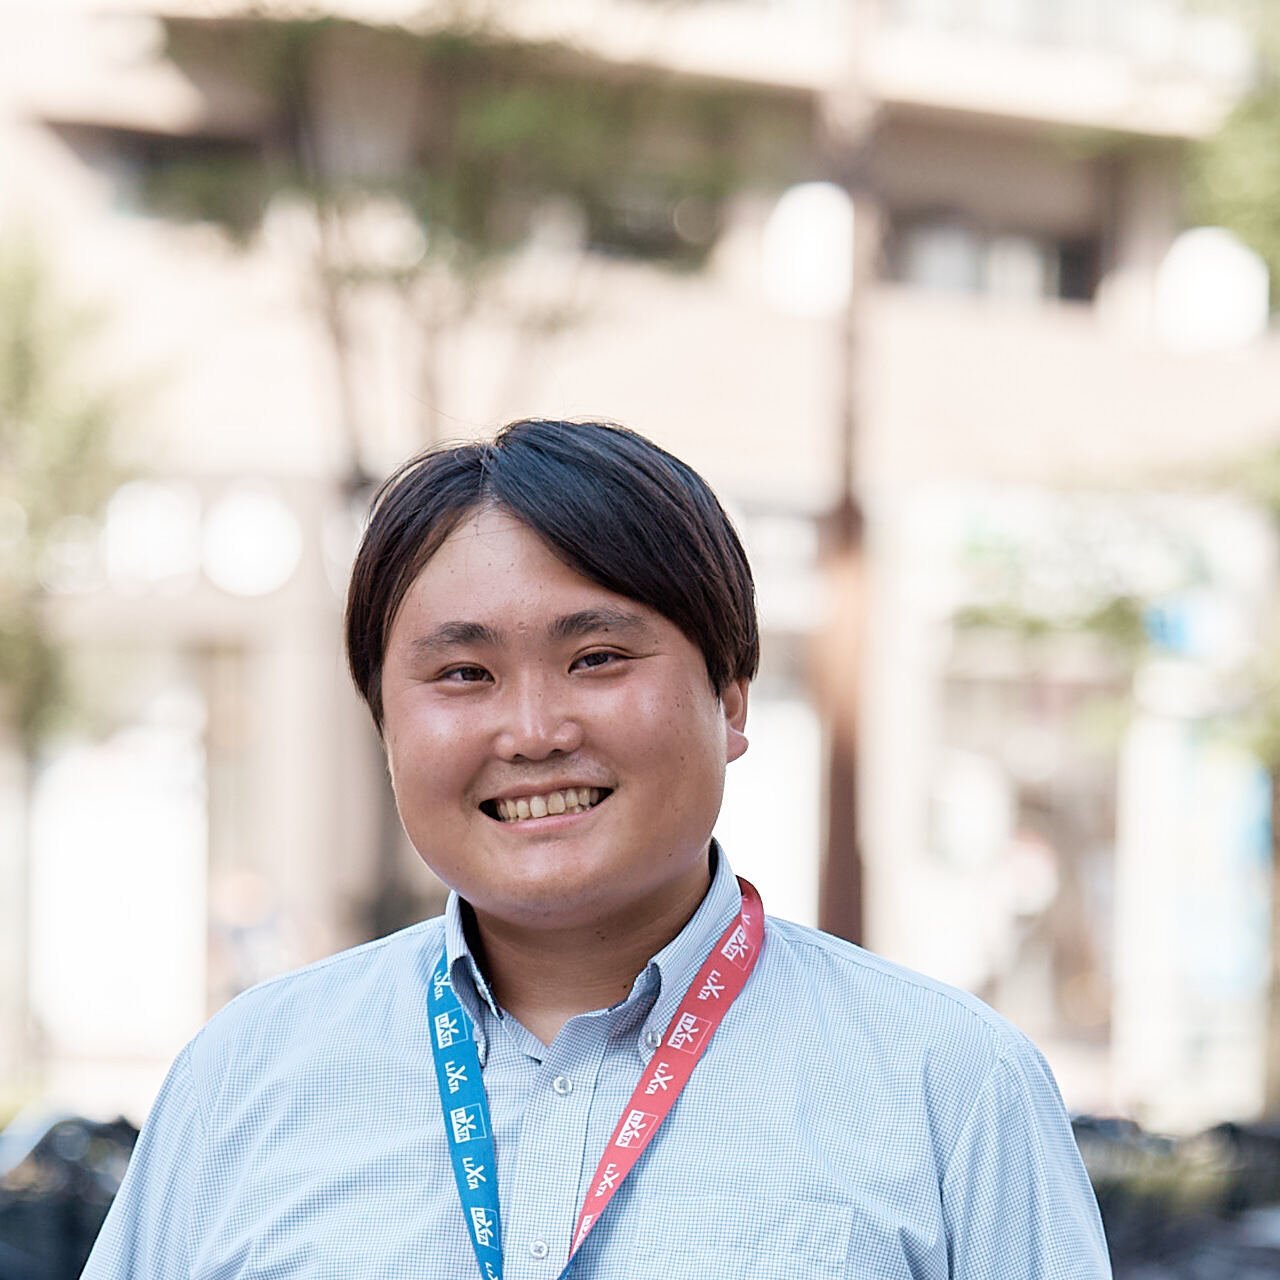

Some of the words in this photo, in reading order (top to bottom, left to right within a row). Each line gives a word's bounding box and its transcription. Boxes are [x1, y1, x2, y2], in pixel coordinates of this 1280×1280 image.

[697, 969, 725, 1000] LIXTA
[439, 1015, 459, 1046] LIXTA
[671, 1015, 699, 1045] LIXTA
[445, 1061, 468, 1094] LIXTA
[644, 1062, 674, 1095] LIXTA
[455, 1110, 477, 1140] LIXTA
[618, 1113, 647, 1145] LIXTA
[462, 1157, 487, 1190] LIXTA
[595, 1163, 620, 1197] LIXTA
[474, 1209, 494, 1242] LIXTA
